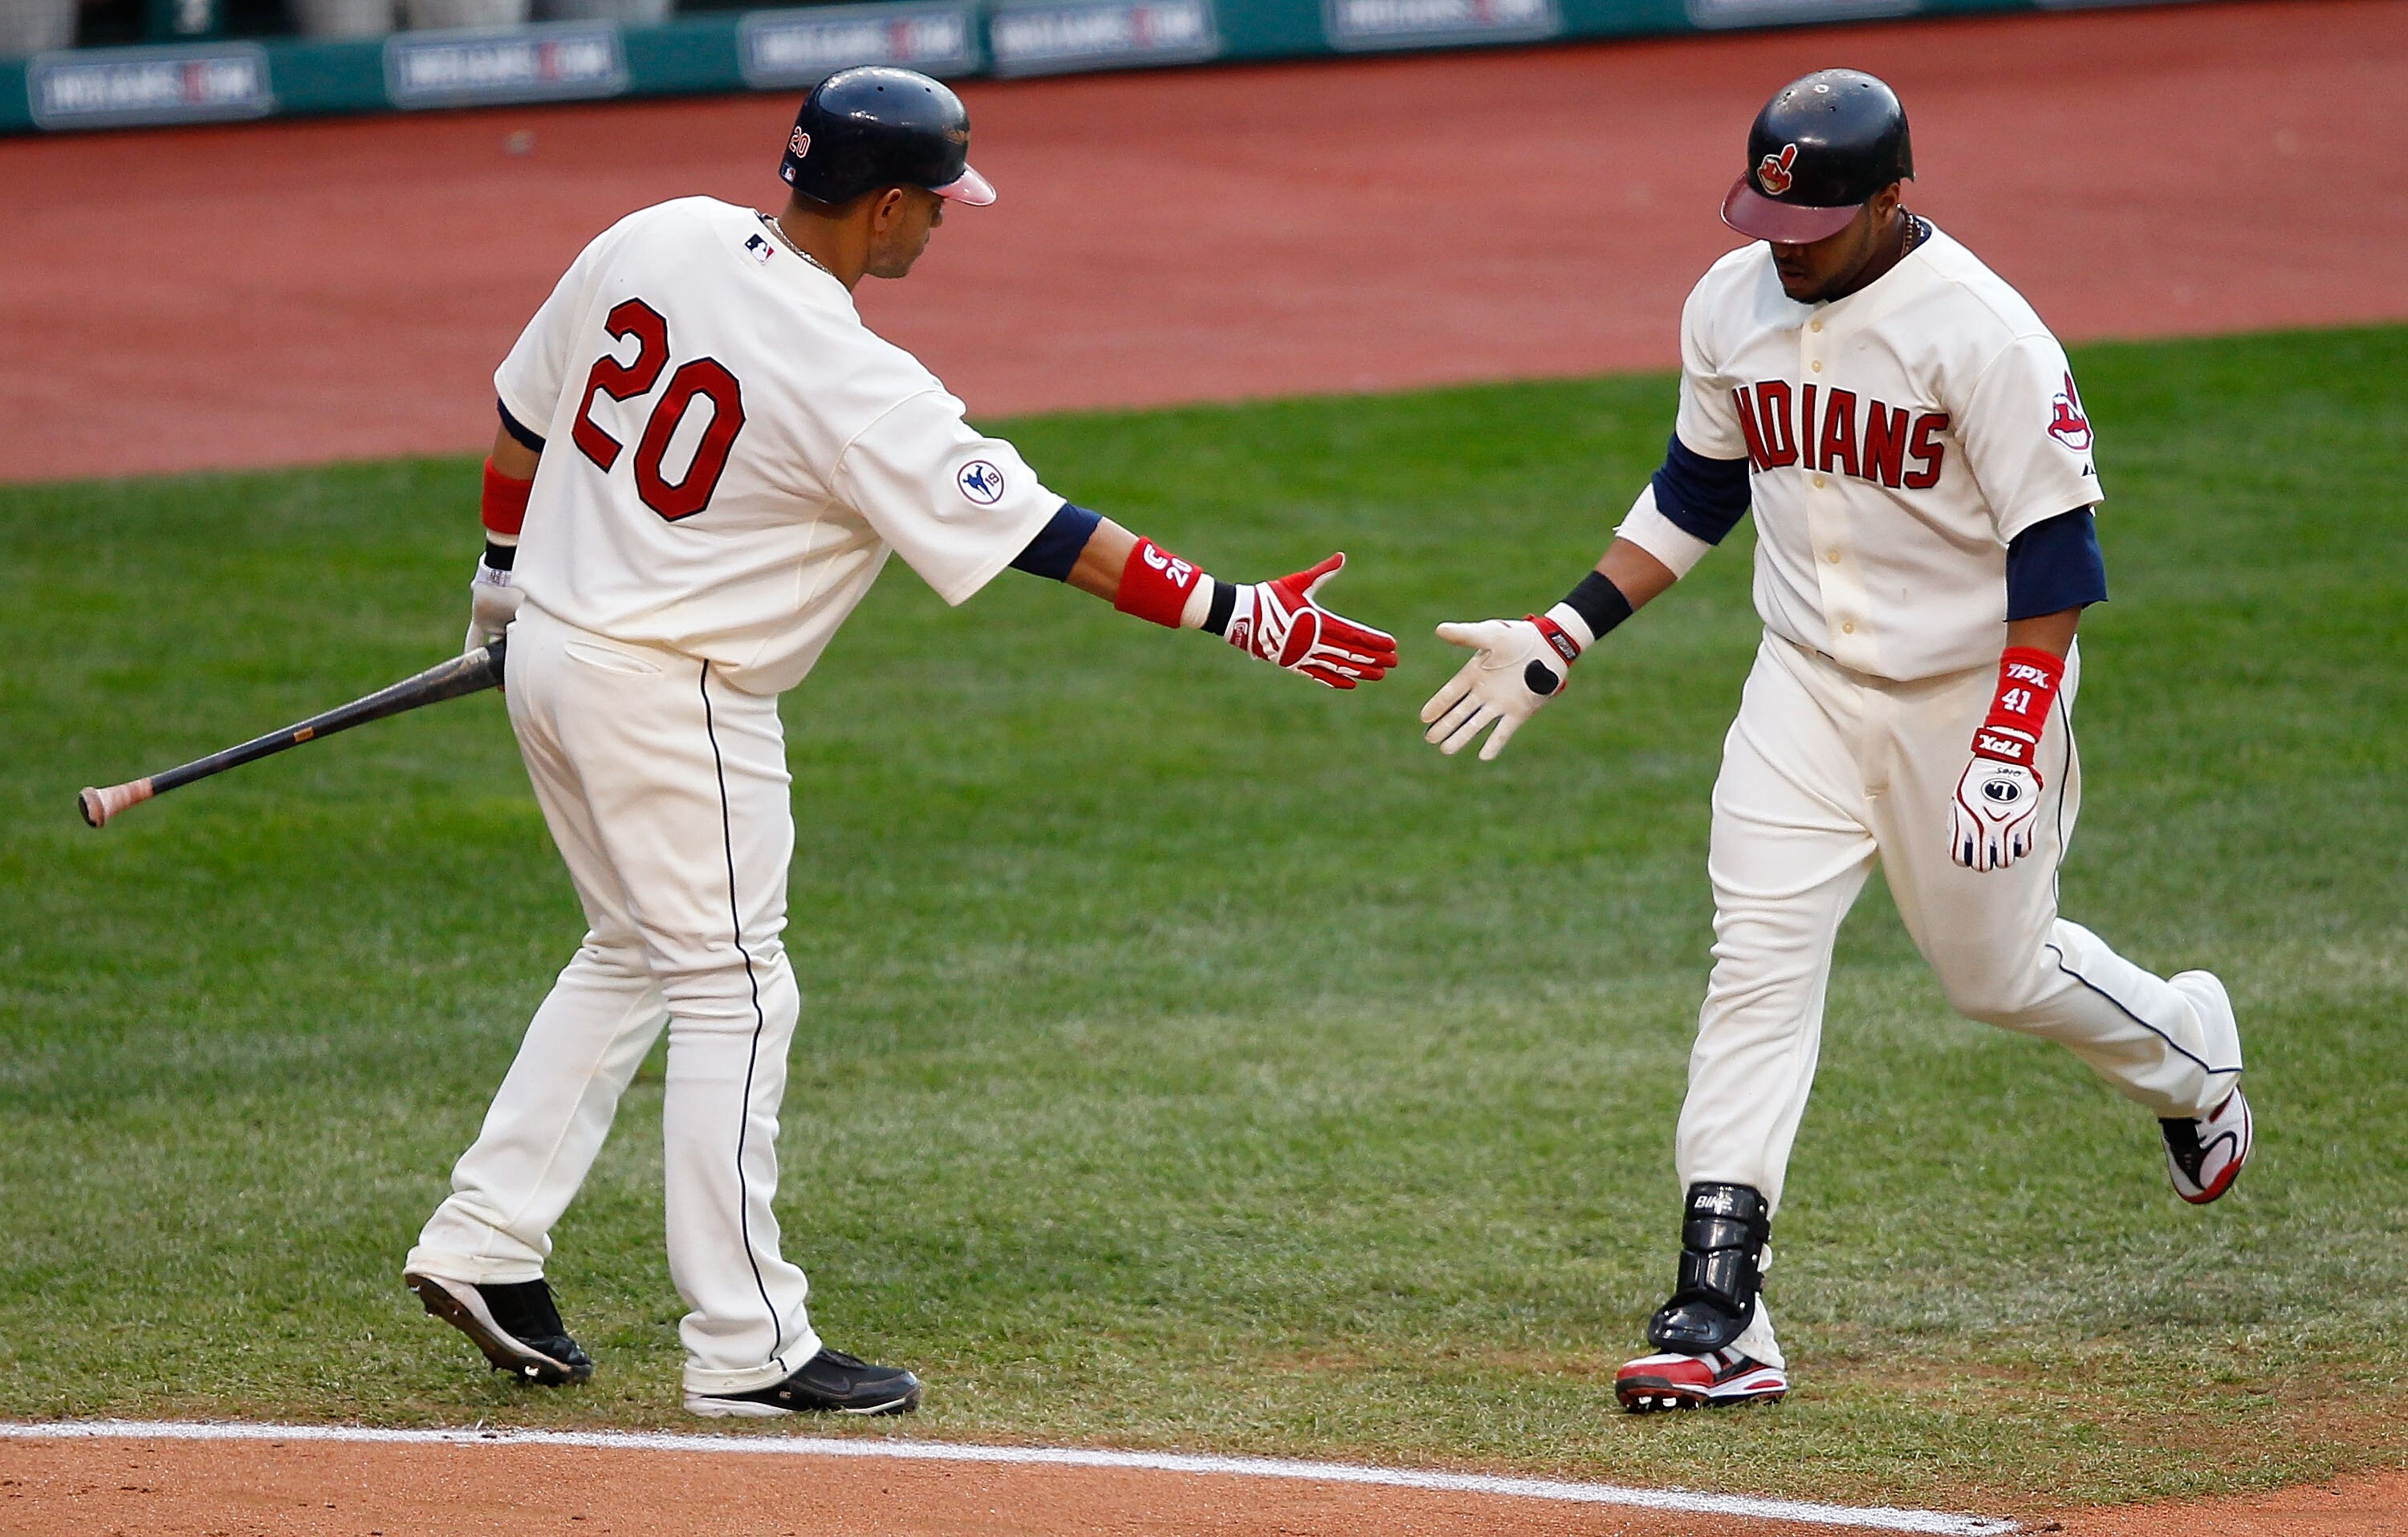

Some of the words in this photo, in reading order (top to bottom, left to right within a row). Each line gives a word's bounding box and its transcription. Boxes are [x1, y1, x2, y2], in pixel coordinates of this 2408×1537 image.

[789, 125, 811, 158] 20
[571, 297, 746, 522] 20
[1732, 379, 1950, 490] NDIANS
[985, 472, 1000, 487] 19
[1165, 558, 1193, 588] 20
[2001, 688, 2032, 714] 41
